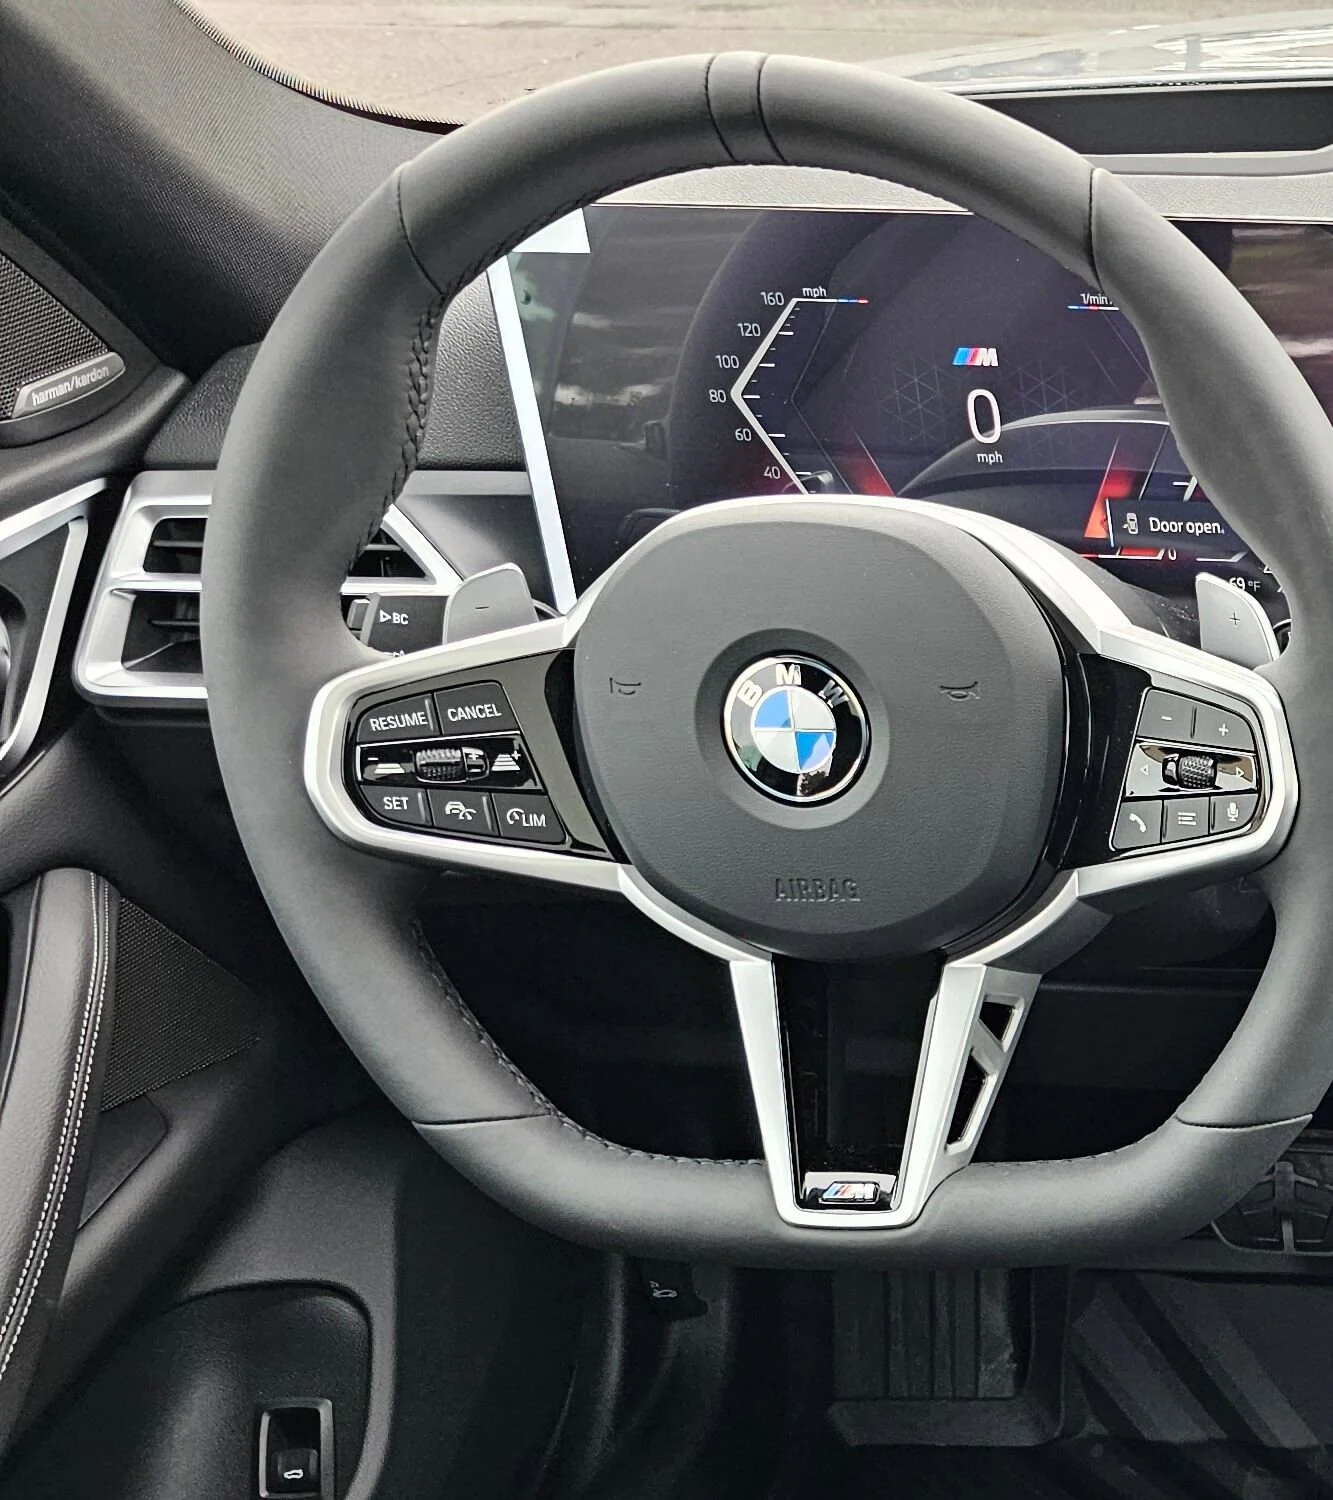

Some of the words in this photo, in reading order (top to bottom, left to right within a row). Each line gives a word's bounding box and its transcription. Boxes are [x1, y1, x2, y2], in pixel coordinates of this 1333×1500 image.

[761, 291, 785, 307] 160
[802, 286, 827, 298] mph
[737, 322, 761, 338] 120
[715, 354, 740, 370] 100
[31, 366, 110, 406] harman/kardon
[708, 389, 727, 404] 80
[967, 388, 1002, 444] 0
[734, 428, 752, 442] 60
[976, 451, 1004, 466] mph
[763, 466, 781, 480] 40
[1149, 517, 1185, 534] Door
[1185, 521, 1225, 537] open.
[1167, 548, 1177, 561] 0
[392, 612, 409, 626] BC
[737, 662, 850, 709] BMW
[447, 703, 503, 723] CANCEL
[369, 711, 428, 732] RESUME
[383, 796, 409, 811] SET
[521, 813, 547, 828] LIM
[774, 876, 862, 903] AIRBAG
